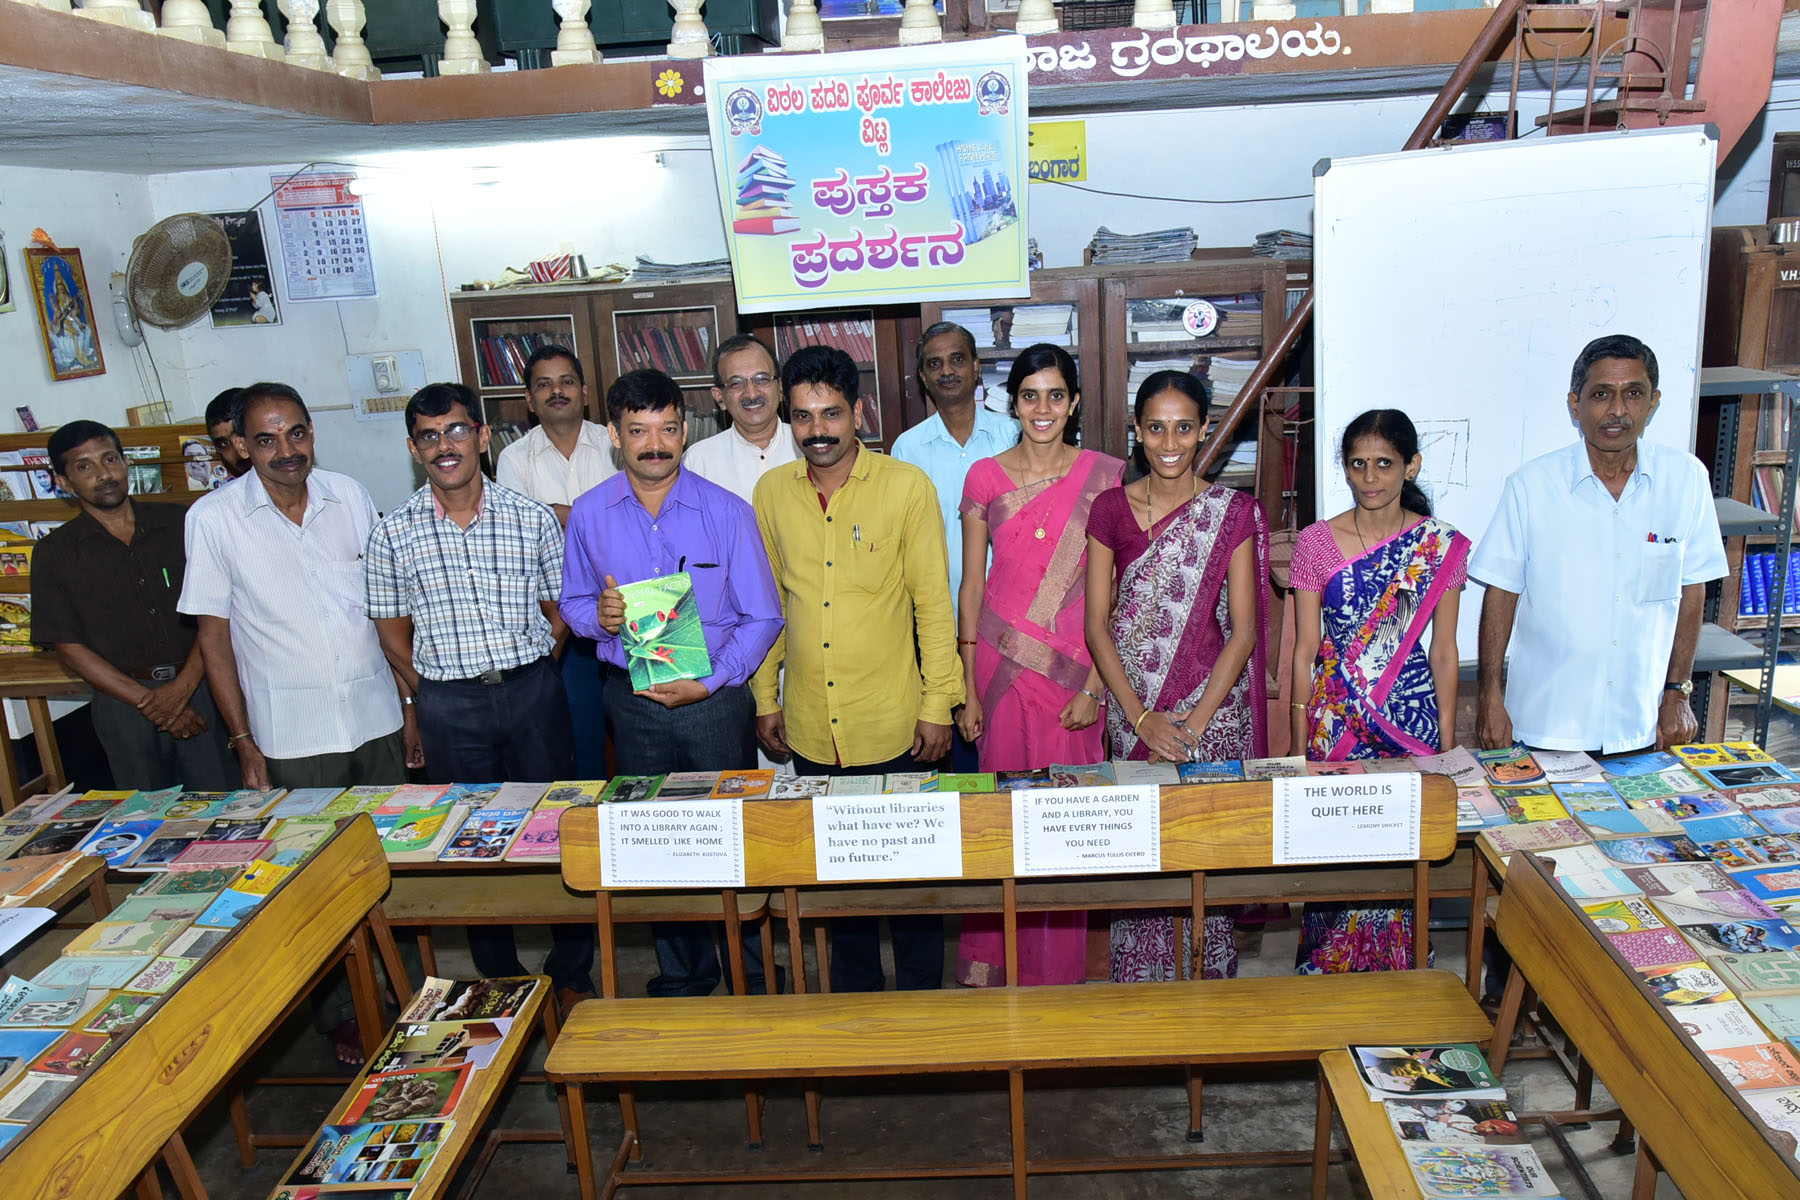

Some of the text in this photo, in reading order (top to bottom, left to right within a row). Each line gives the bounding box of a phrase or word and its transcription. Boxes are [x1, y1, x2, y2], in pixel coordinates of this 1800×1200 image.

[1110, 22, 1352, 77] ಗ್ರಂಥಾಲಯ.
[810, 79, 849, 109] ಪದವಿ
[856, 76, 904, 112] ಪೂರ್ವ
[911, 71, 971, 102] ಕಾಲೇಜು
[862, 118, 889, 153] ವಿಟ್ಲ
[812, 162, 929, 218] ಪುಸ್ತಕ
[791, 222, 967, 288] ಪ್ರದರ್ಶನ
[1304, 784, 1392, 797] THE WORLD IS
[1035, 797, 1043, 805] IF
[1045, 797, 1064, 805] YOU
[1066, 796, 1090, 804] HAVE
[1102, 794, 1140, 803] GARDEN
[631, 810, 651, 818] WAS
[653, 810, 680, 818] GOOD
[695, 810, 721, 818] WALK
[826, 802, 945, 815] “Without libraries
[1041, 811, 1061, 819] AND
[1072, 809, 1112, 818] LIBRARY,
[1114, 808, 1134, 816] YOU
[1311, 805, 1384, 818] QUIET HERE
[827, 818, 945, 831] what have we? We
[1043, 822, 1133, 832] HAVE EVERY THINGS
[631, 837, 670, 845] SMELLED
[674, 837, 691, 845] LIKE
[696, 837, 723, 845] HOME
[828, 833, 936, 848] have no past and
[1065, 838, 1111, 847] YOU NEED
[829, 850, 900, 863] no future.”
[1526, 1165, 1538, 1179] OUR
